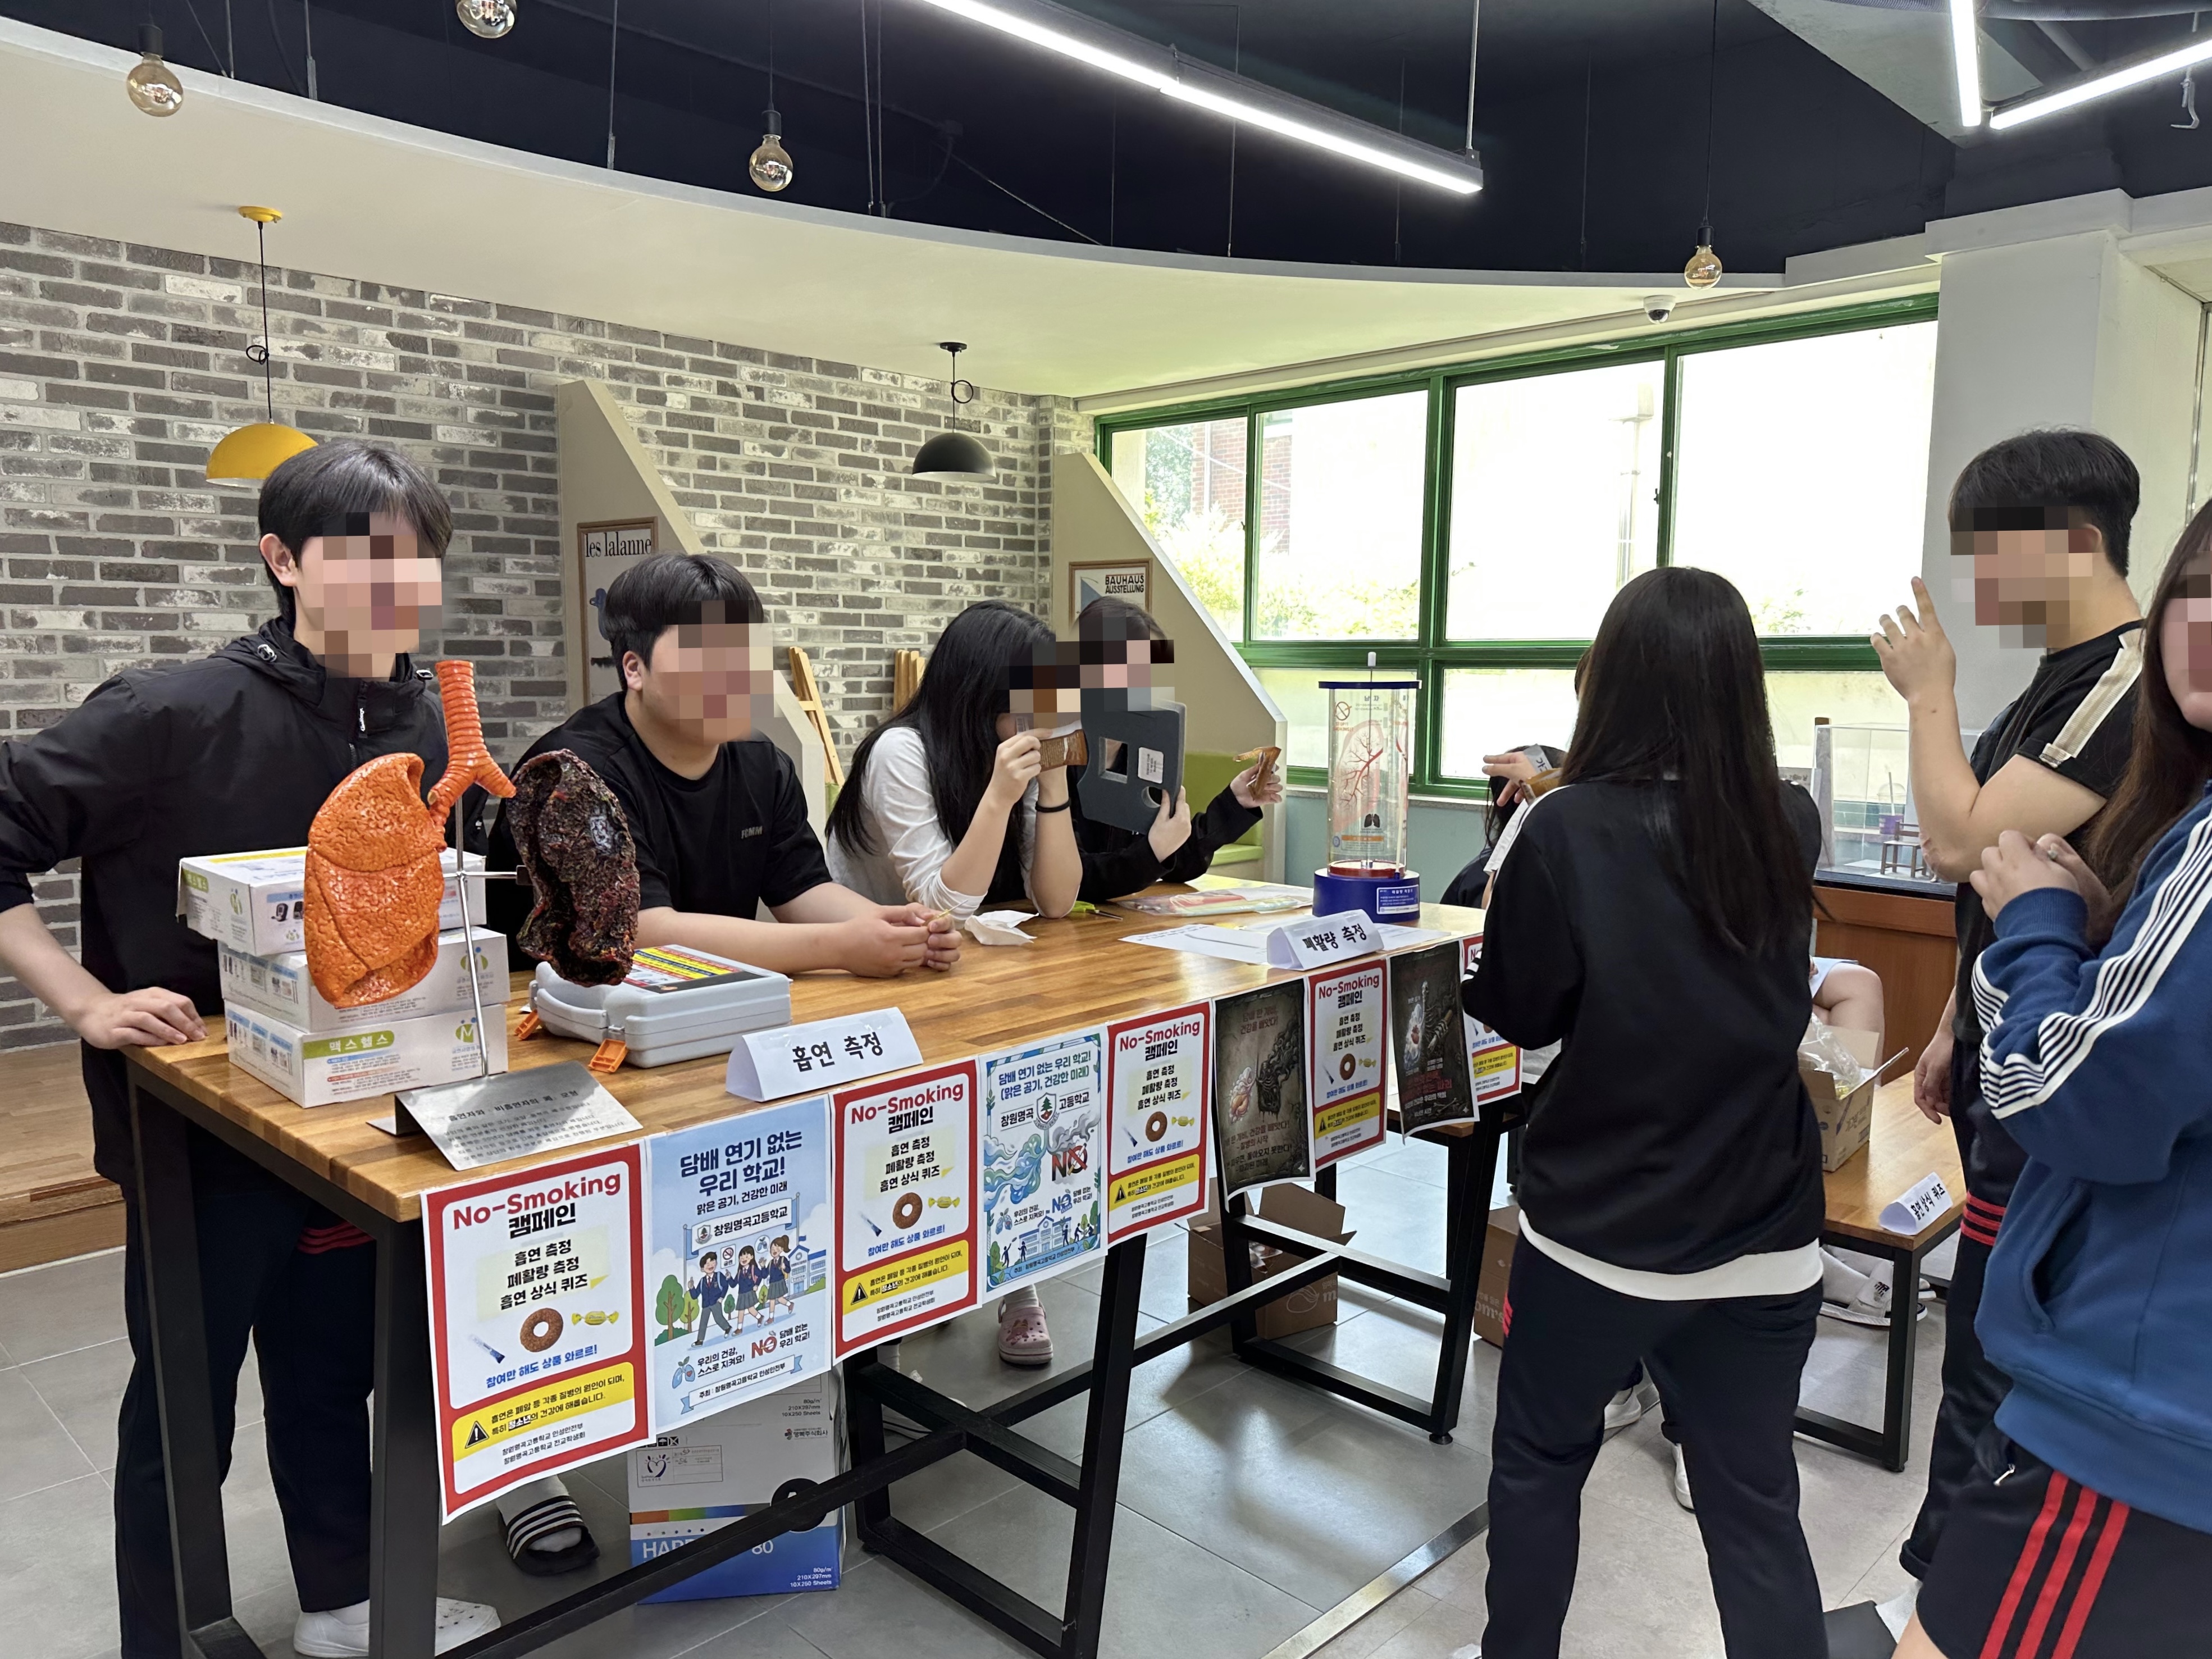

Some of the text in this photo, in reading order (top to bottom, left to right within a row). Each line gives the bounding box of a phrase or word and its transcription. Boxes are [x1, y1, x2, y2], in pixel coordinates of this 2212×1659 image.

[585, 531, 651, 557] les lalanne
[1105, 575, 1144, 585] BAUHAUS
[1105, 585, 1144, 594] AUSSTELLUNG
[1302, 923, 1367, 951] 폐활량 측정
[1319, 975, 1379, 999] No-Smoking
[1338, 990, 1362, 1009] 캠페인
[329, 1034, 389, 1052] 맥스헬스
[1120, 1021, 1200, 1051] No-Smoking
[1145, 1040, 1178, 1061] 캠페인
[792, 1032, 884, 1072] 흡연 측정
[999, 1051, 1091, 1086] 담배 연기 없는 우리 학교!
[1001, 1065, 1089, 1100] (맑은 공기, 건강한 미래)
[1147, 1065, 1174, 1081] 흡연 측정
[851, 1083, 963, 1124] No-Smoking
[1001, 1092, 1089, 1127] 창원명곡 고등학교
[1138, 1090, 1181, 1110] 흡연 상식 퀴즈
[888, 1106, 933, 1134] 캠페인
[680, 1131, 802, 1178] 담배 연기 없는
[891, 1136, 930, 1157] 흡연 측정
[699, 1156, 785, 1196] 우리 학교!
[886, 1151, 934, 1175] 폐활량 측정
[881, 1165, 939, 1192] 흡연 상식 퀴즈
[453, 1173, 621, 1230] No-Smoking
[697, 1181, 787, 1215] 맑은 공기, 건강한 미래
[1910, 1183, 1945, 1220] 흡연 상식 퀴즈
[509, 1202, 576, 1239] 캠페인
[714, 1206, 788, 1237] 창원명곡고등학교
[515, 1239, 571, 1266] 흡연 측정
[868, 1224, 945, 1256] 참여만 해도 상품 와르르!
[508, 1256, 579, 1288] 폐활량 측정
[501, 1274, 587, 1310] 흡연 상식 퀴즈
[779, 1323, 808, 1339] 담배 없는
[779, 1330, 810, 1348] 우리 학교!
[486, 1344, 598, 1388] 참여만 해도 상품 와르르!
[697, 1347, 738, 1366] 우리의 건강,
[697, 1354, 745, 1376] 스스로 지켜요!
[491, 1409, 514, 1424] 흡연은
[516, 1402, 531, 1415] 폐암
[543, 1394, 557, 1405] 각종
[559, 1386, 582, 1402] 질병의
[583, 1379, 605, 1393] 원인이
[608, 1374, 624, 1385] 되며,
[491, 1392, 605, 1435] 특히 청소년의 건강에 해롭습니다.
